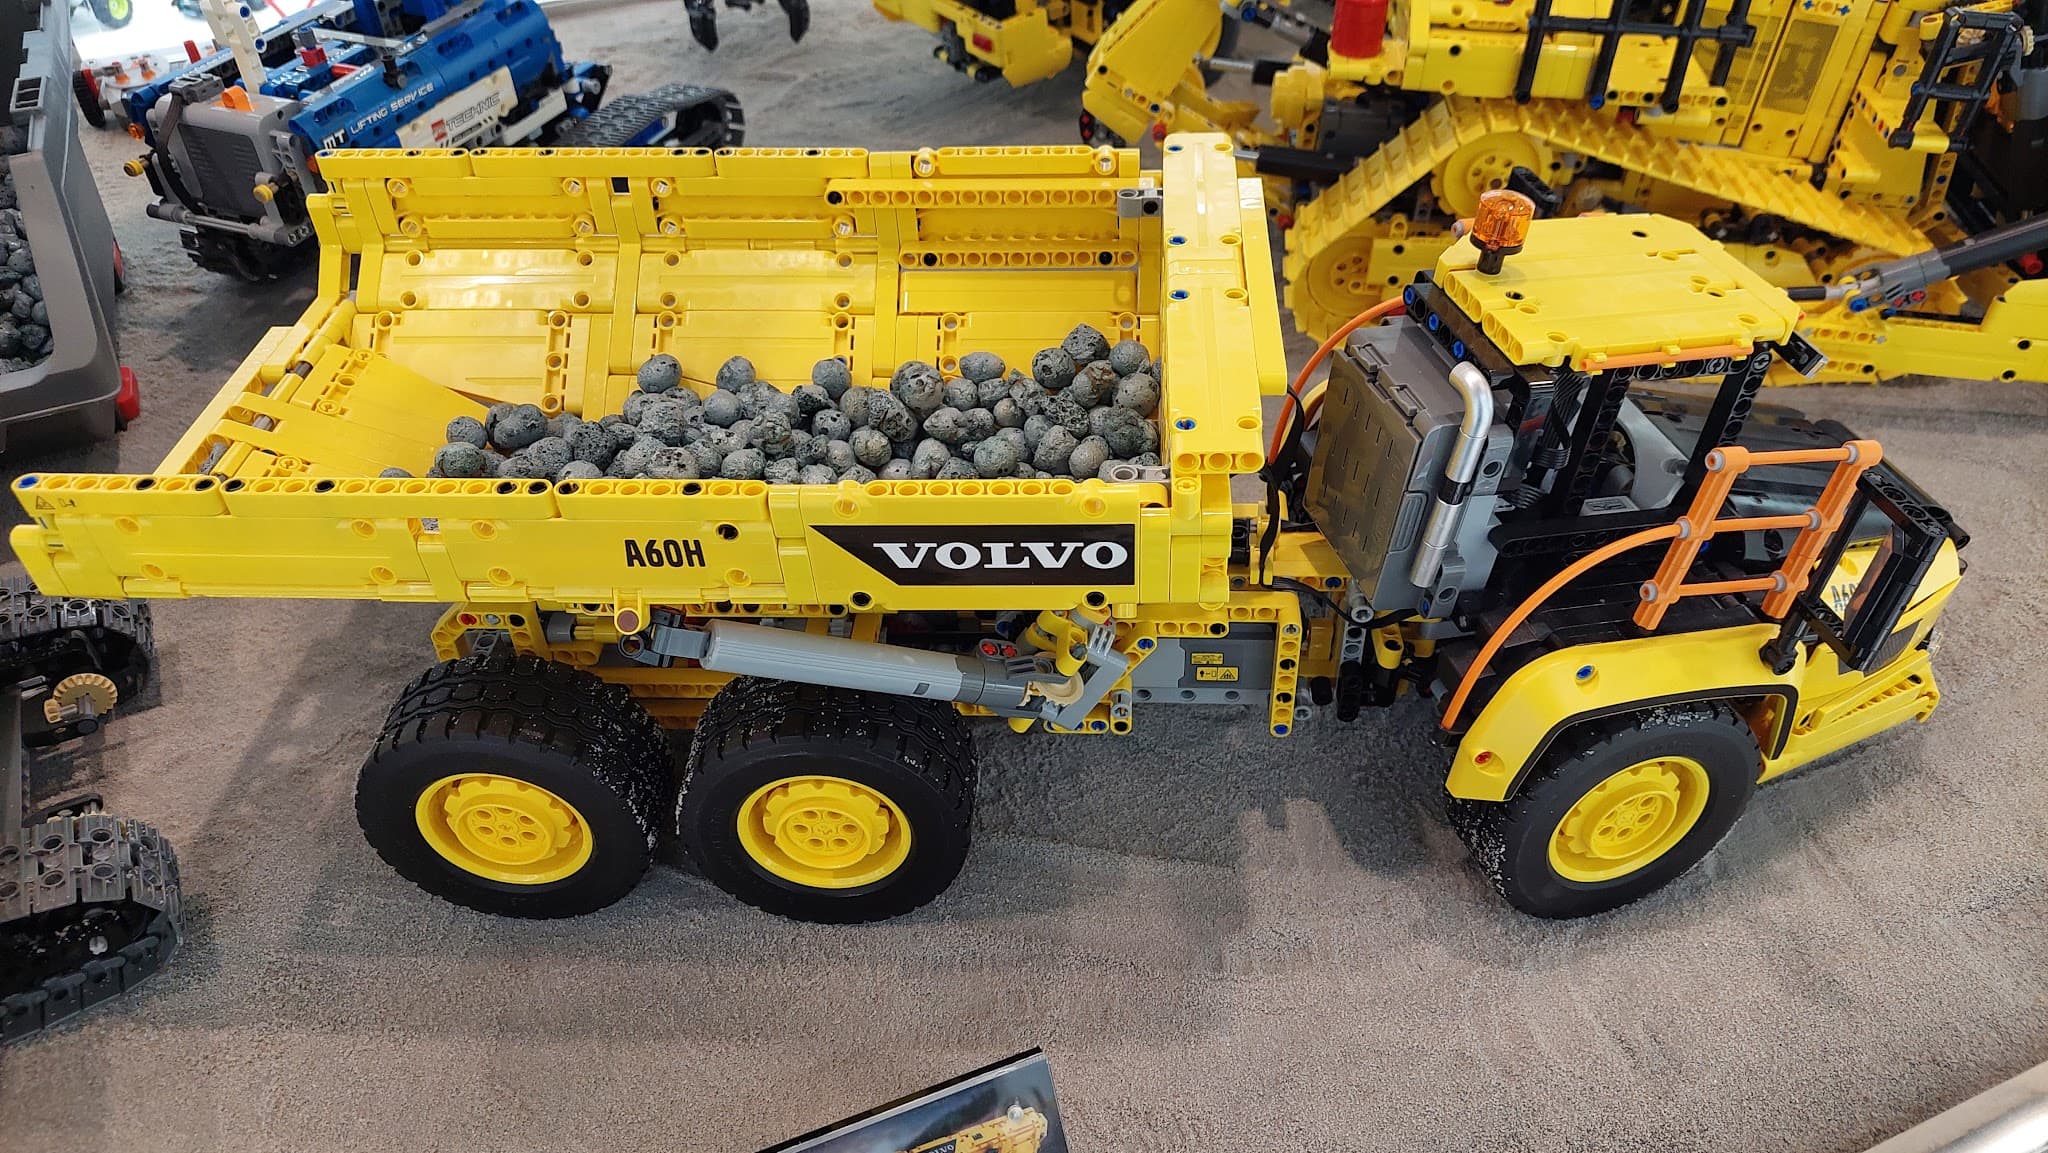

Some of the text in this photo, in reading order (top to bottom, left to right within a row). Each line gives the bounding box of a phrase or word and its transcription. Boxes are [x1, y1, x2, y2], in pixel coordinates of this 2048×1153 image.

[323, 83, 434, 148] MT LIFTING SERVICE
[446, 92, 500, 131] TECHNIC
[624, 539, 706, 567] A60H
[873, 541, 1128, 569] VOLVO
[1831, 583, 1859, 611] A6
